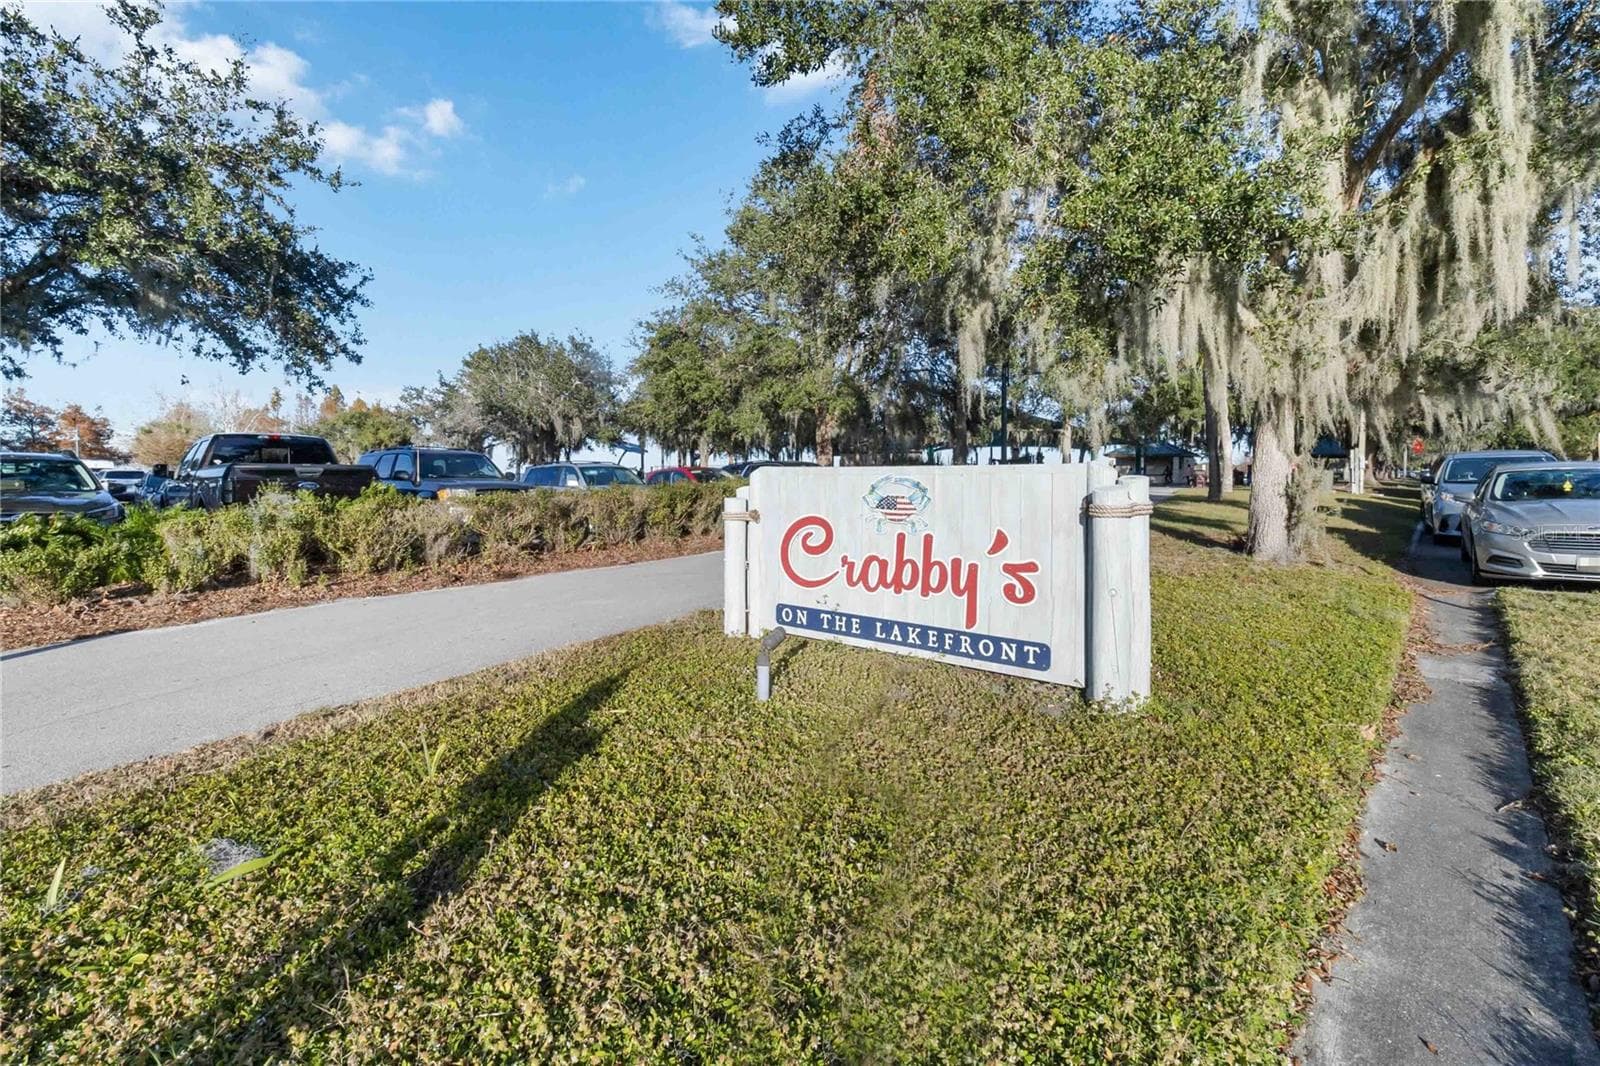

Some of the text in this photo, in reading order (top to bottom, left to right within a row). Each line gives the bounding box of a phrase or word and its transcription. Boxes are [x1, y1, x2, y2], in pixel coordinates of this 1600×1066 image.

[780, 515, 1038, 629] Crabby's
[781, 607, 1041, 665] ON THE LAKEFRONT
